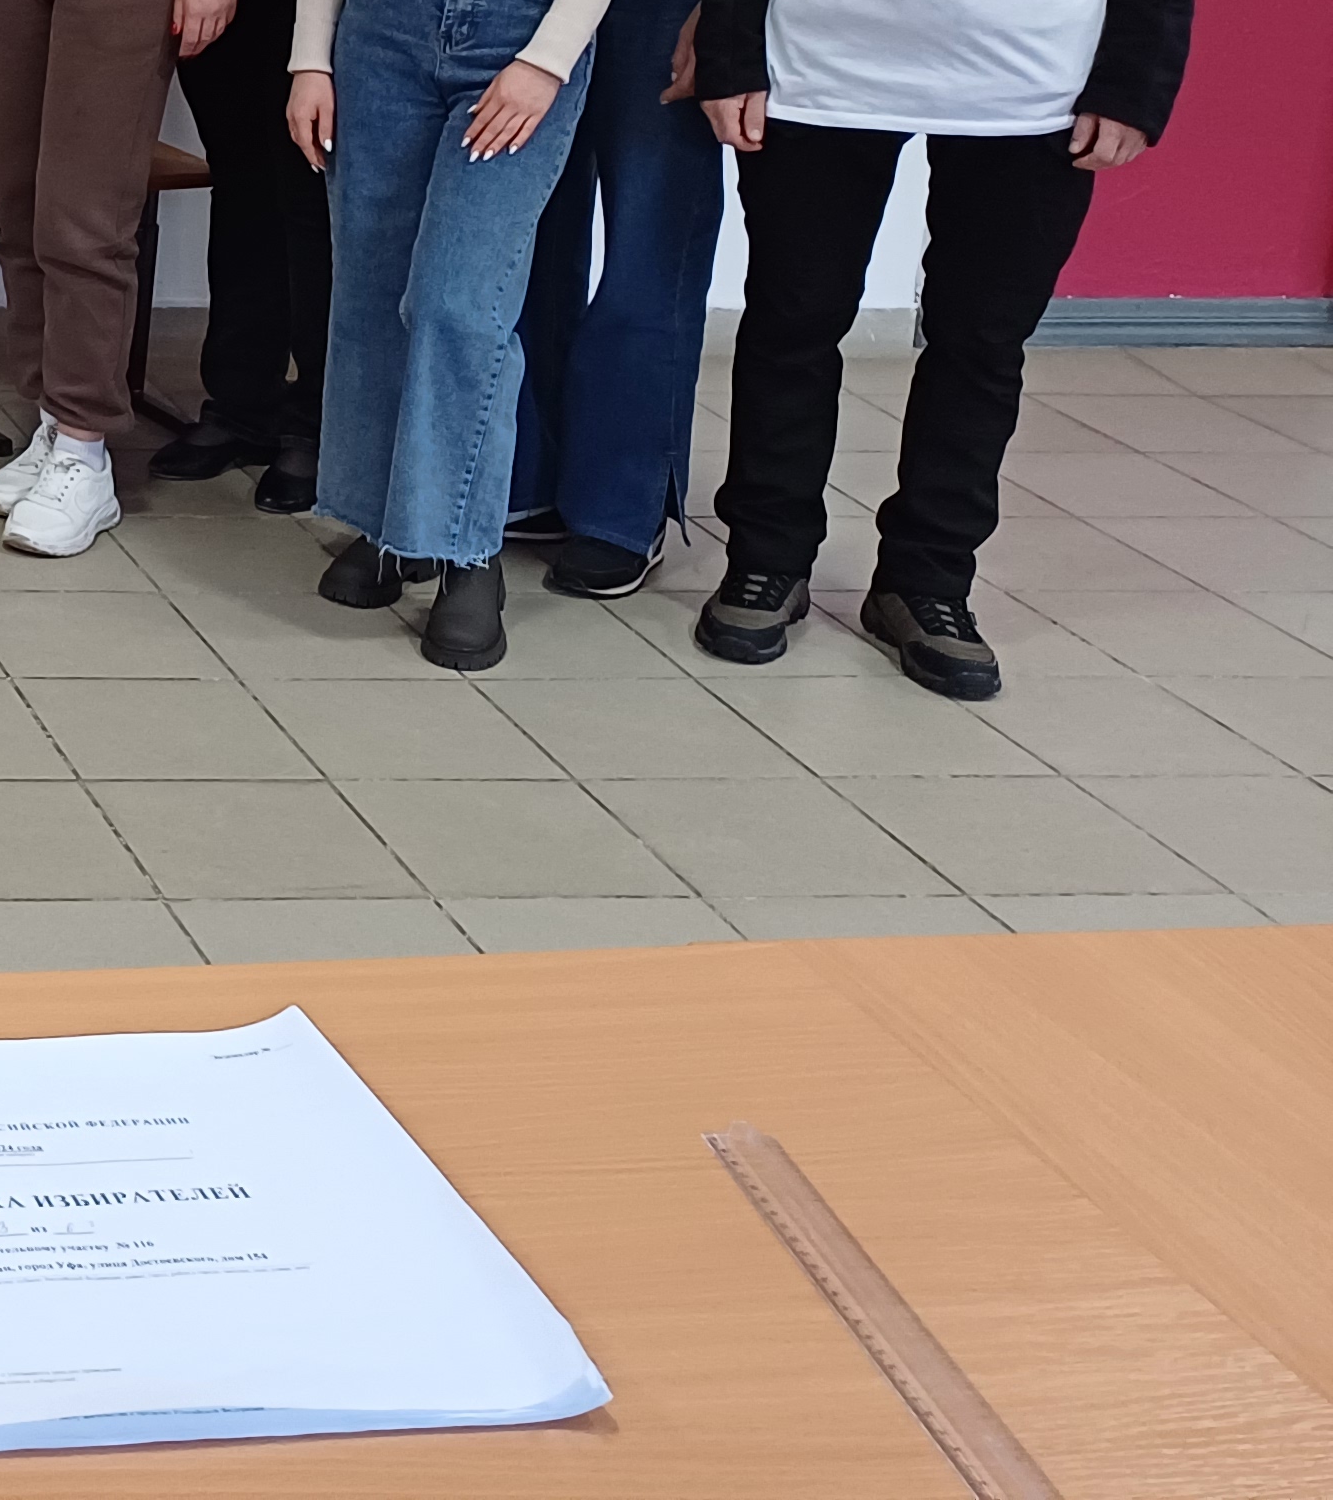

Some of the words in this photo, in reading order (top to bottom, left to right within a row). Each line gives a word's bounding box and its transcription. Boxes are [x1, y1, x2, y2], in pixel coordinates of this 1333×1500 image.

[85, 1116, 190, 1128] ФЕДЕРАЦИИ
[32, 1183, 252, 1208] ИЗБИРАТЕЛЕЙ
[60, 1243, 109, 1253] участку
[133, 1240, 155, 1248] 116
